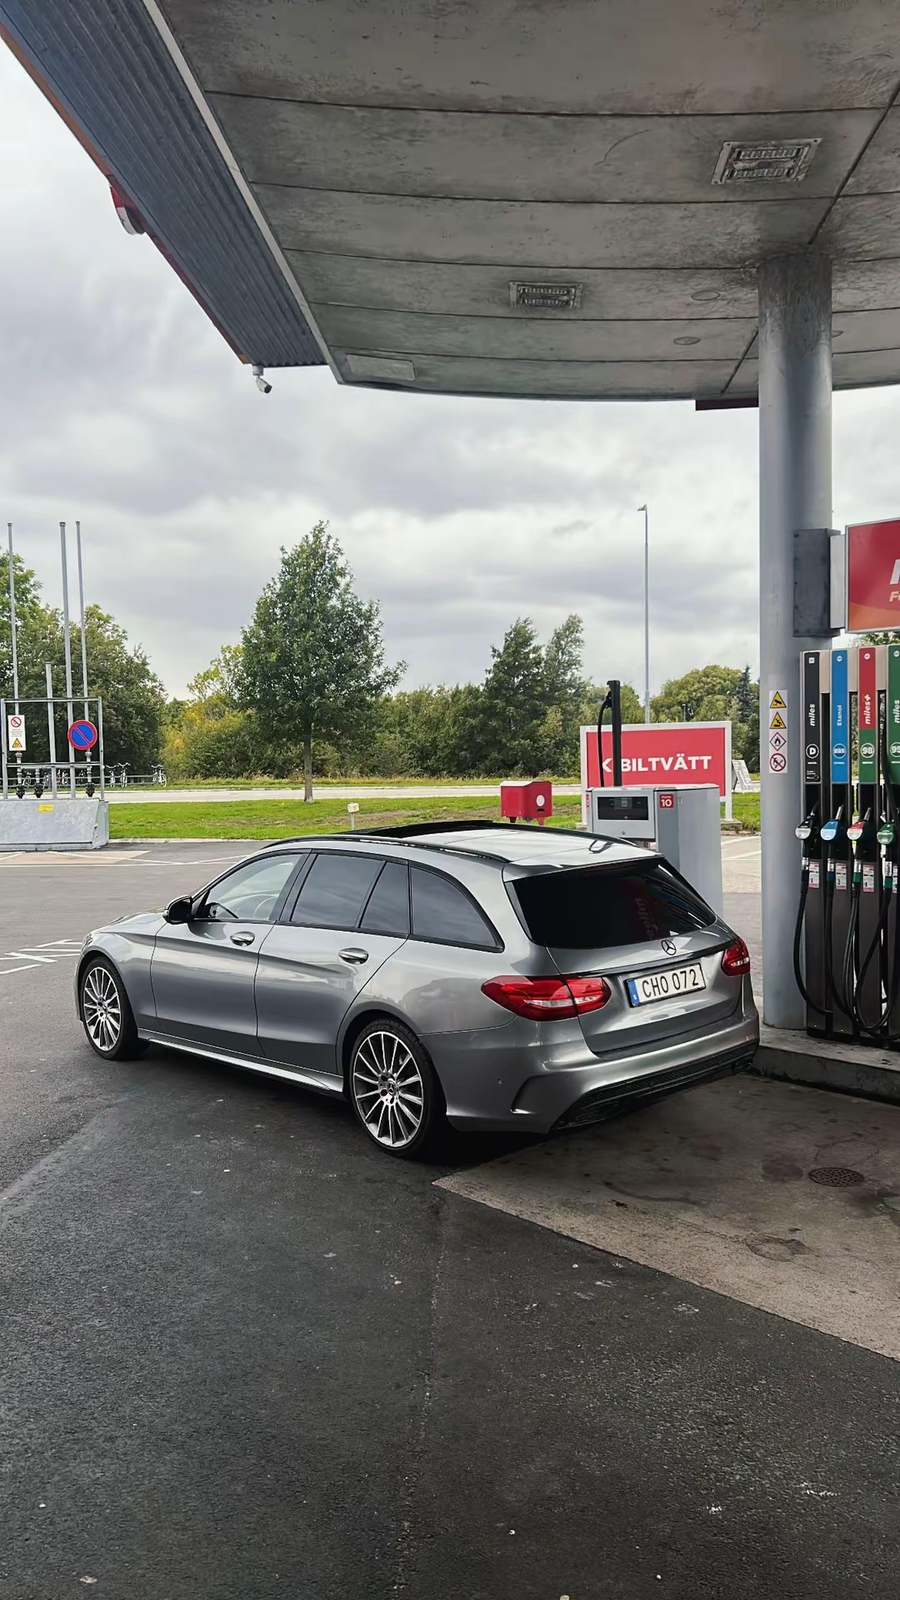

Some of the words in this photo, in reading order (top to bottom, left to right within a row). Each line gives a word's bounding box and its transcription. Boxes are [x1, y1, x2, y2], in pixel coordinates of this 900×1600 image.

[862, 746, 873, 755] 98
[620, 753, 712, 773] BILTVÄTT
[661, 798, 672, 807] 10
[642, 975, 669, 998] CHO
[671, 968, 699, 990] 072
